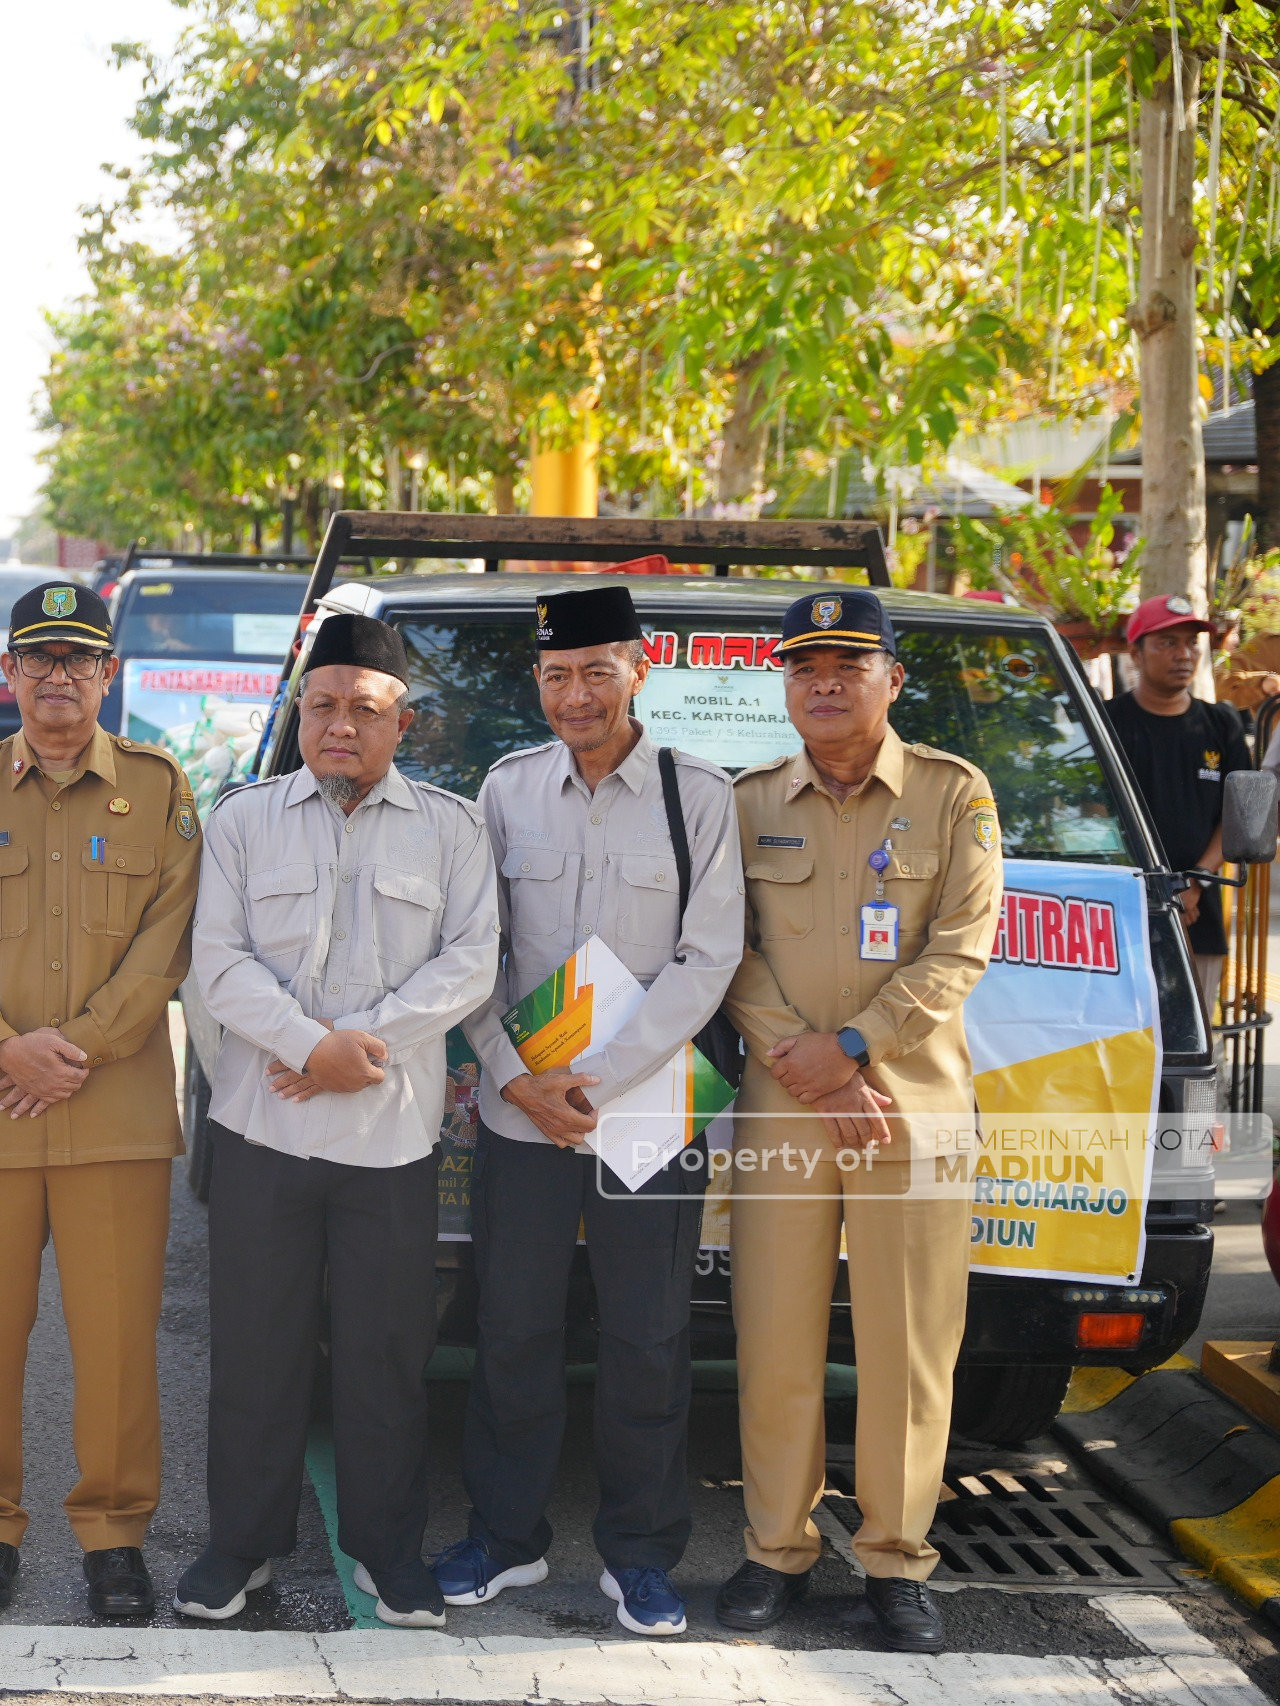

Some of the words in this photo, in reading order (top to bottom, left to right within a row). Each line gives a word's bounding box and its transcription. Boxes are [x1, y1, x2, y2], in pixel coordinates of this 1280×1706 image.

[683, 695, 733, 706] MOBIL
[738, 698, 761, 707] A.1
[651, 710, 687, 720] KEC.
[692, 711, 793, 724] KARTOHARJ
[682, 727, 712, 737] Paket
[737, 728, 796, 739] Kelurahan
[972, 1176, 1128, 1216] RTOHARJO
[970, 1217, 1037, 1249] DIUN
